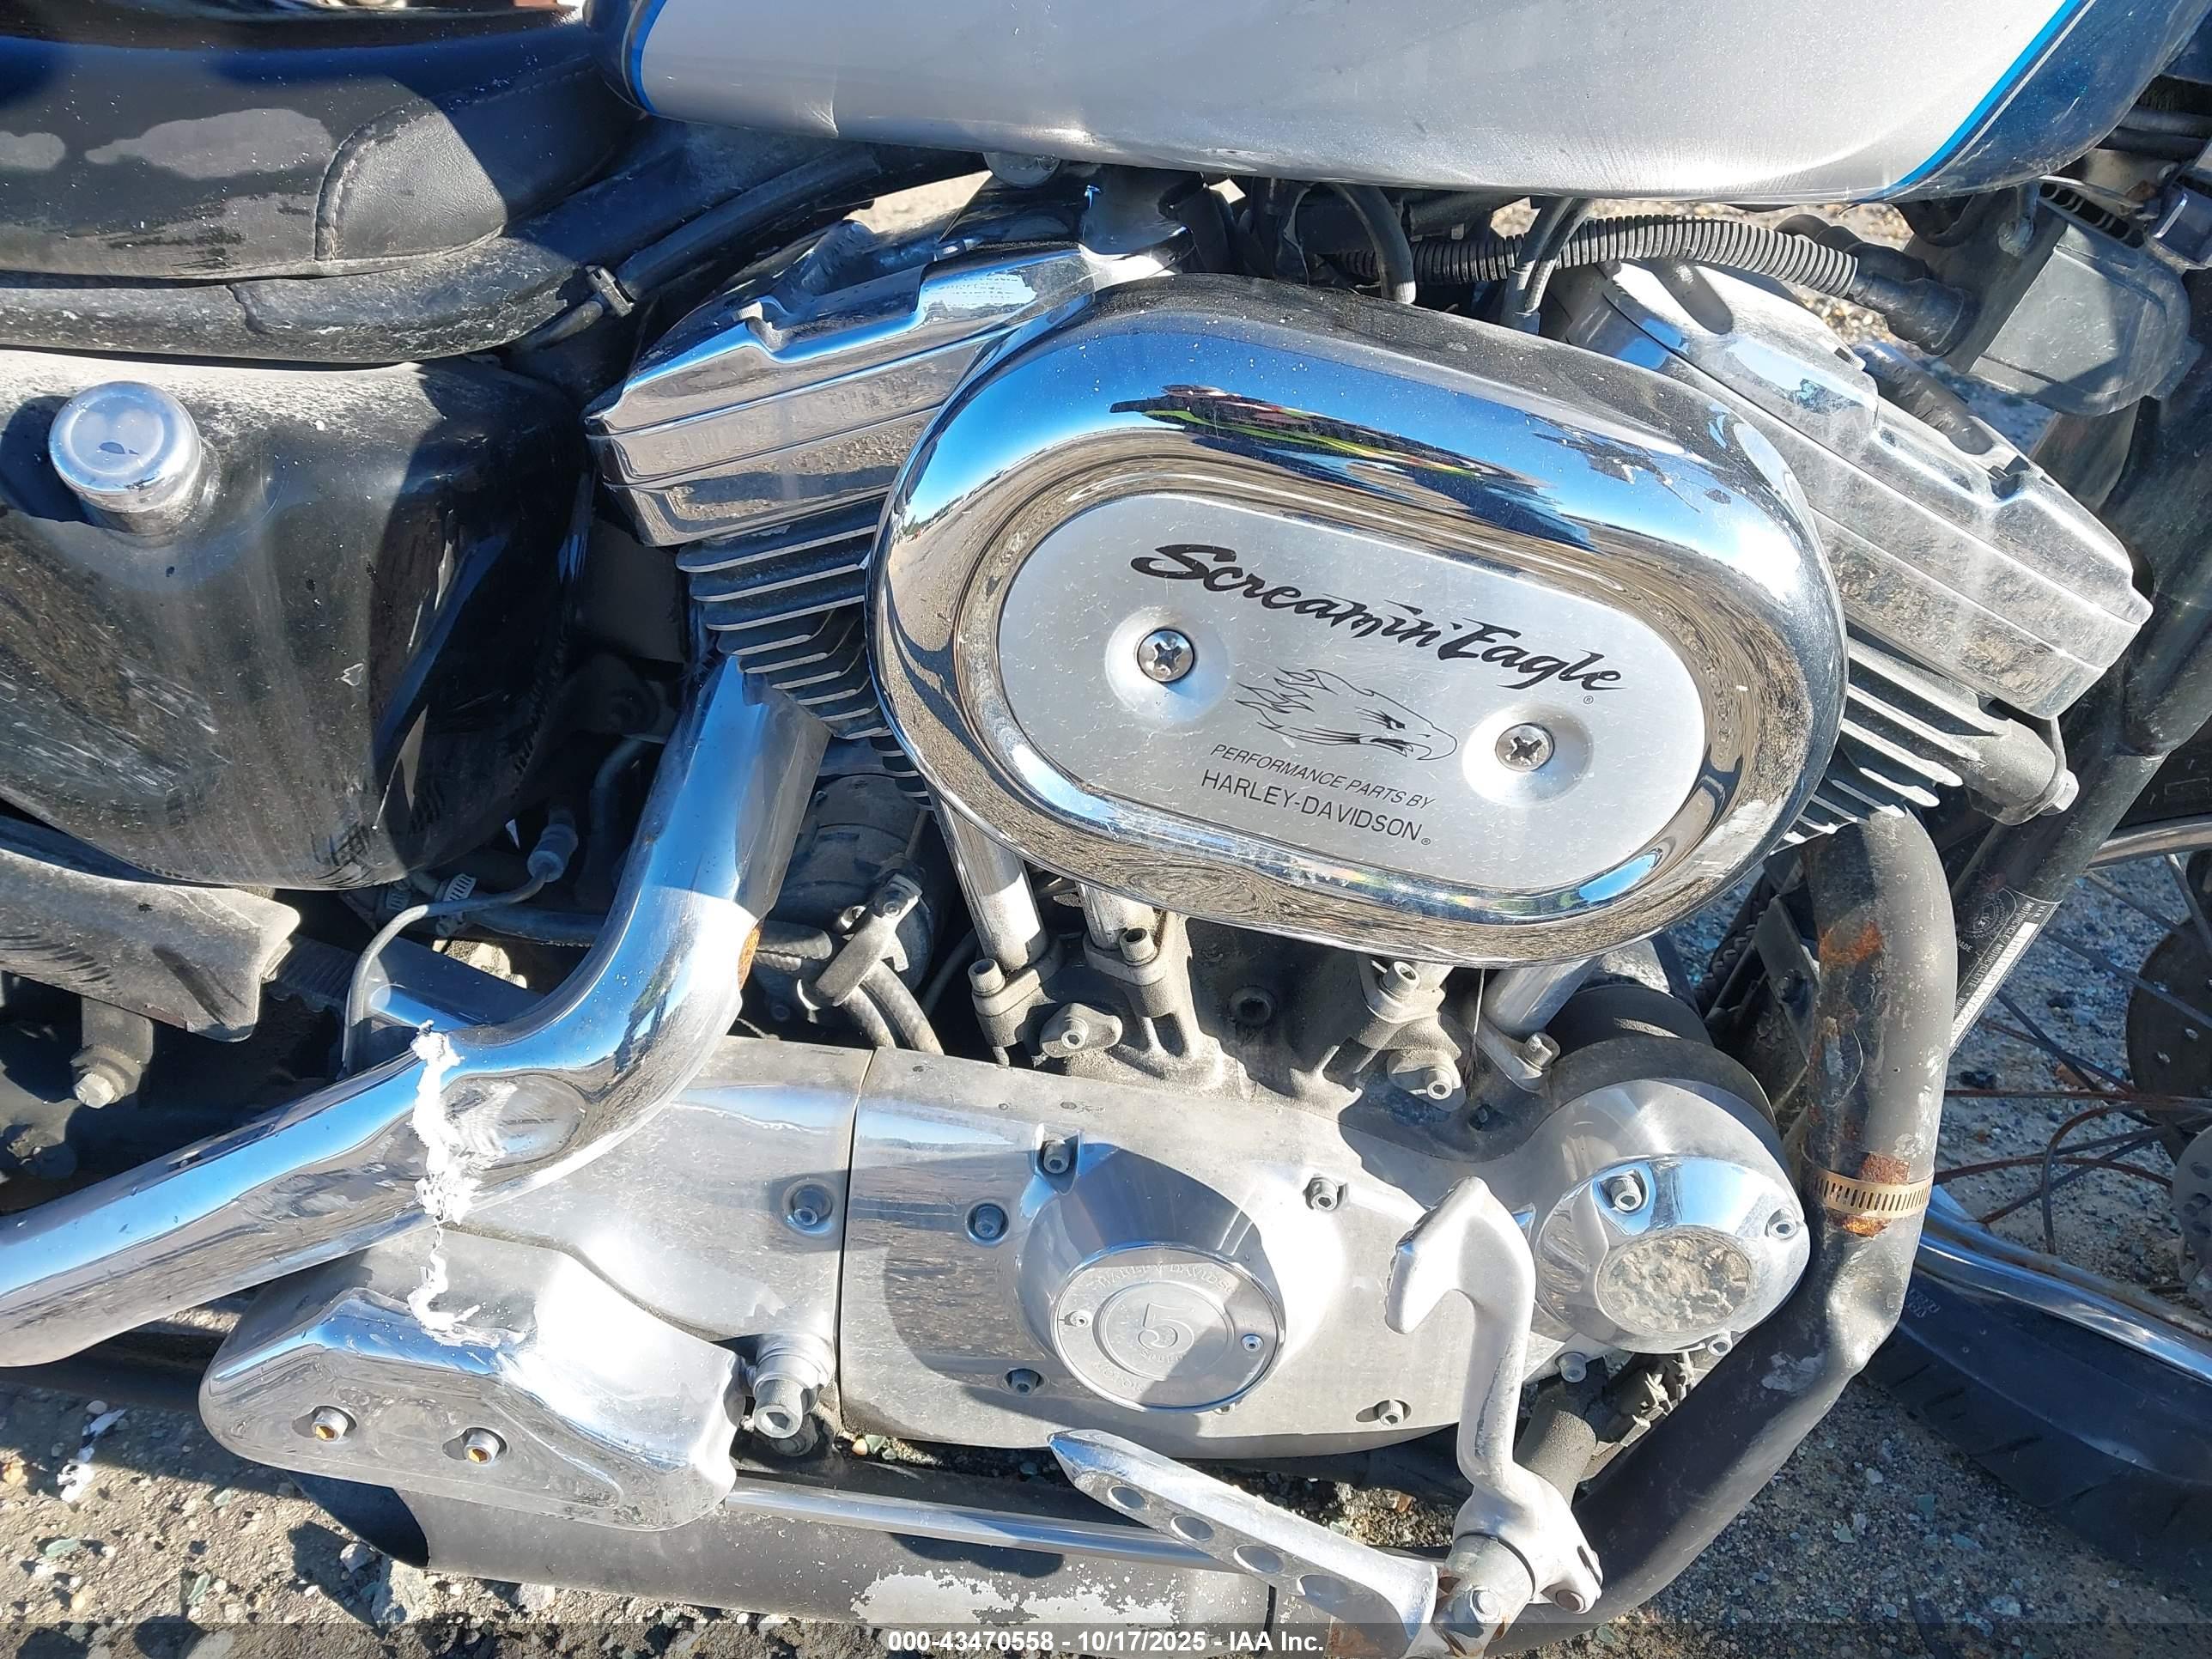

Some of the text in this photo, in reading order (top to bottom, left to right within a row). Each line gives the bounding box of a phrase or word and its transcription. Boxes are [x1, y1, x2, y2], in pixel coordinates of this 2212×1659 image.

[1437, 617, 1627, 691] Eagle
[1200, 769, 1423, 841] HARLEY-DAVIDSON
[1210, 744, 1437, 811] PERFORMANCE PARTS BY
[1138, 1302, 1194, 1354] 5
